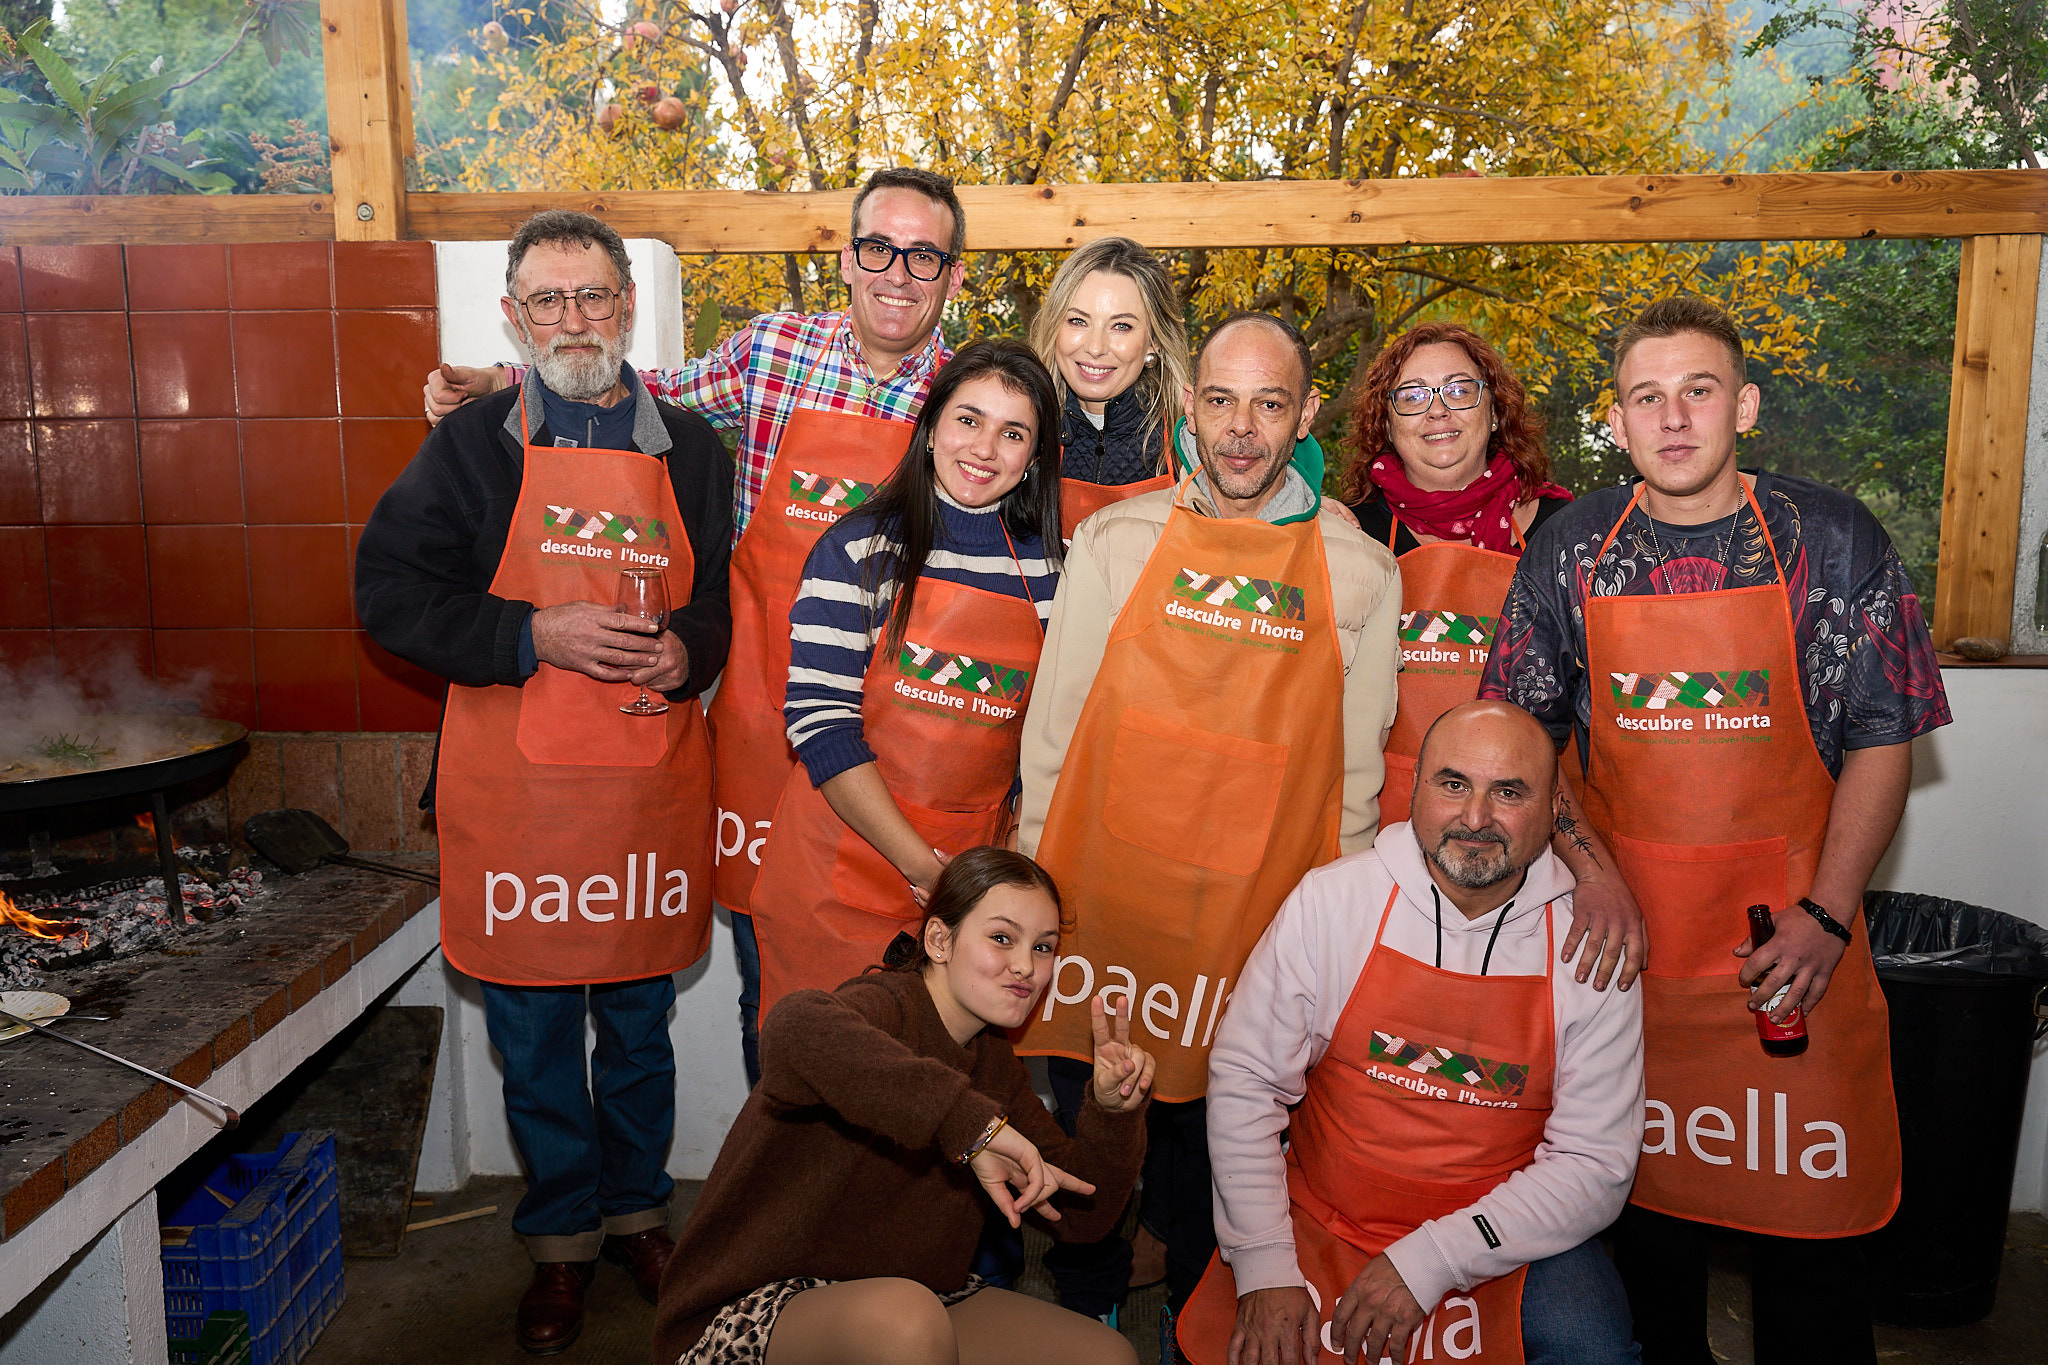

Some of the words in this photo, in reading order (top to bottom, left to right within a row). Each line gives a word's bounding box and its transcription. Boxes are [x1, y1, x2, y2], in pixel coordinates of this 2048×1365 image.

[785, 503, 842, 523] descub
[540, 538, 612, 559] descubre
[620, 547, 670, 567] l'horta
[1165, 600, 1242, 630] descubre
[1250, 617, 1304, 641] l'horta
[1402, 646, 1460, 663] scubre
[1469, 648, 1489, 663] l'h
[894, 678, 965, 709] descubre
[1616, 712, 1694, 731] descubre
[1705, 713, 1771, 730] l'horta
[715, 806, 773, 868] pa
[485, 852, 689, 937] paella
[1041, 954, 1234, 1049] paell
[1640, 1087, 1848, 1180] aella
